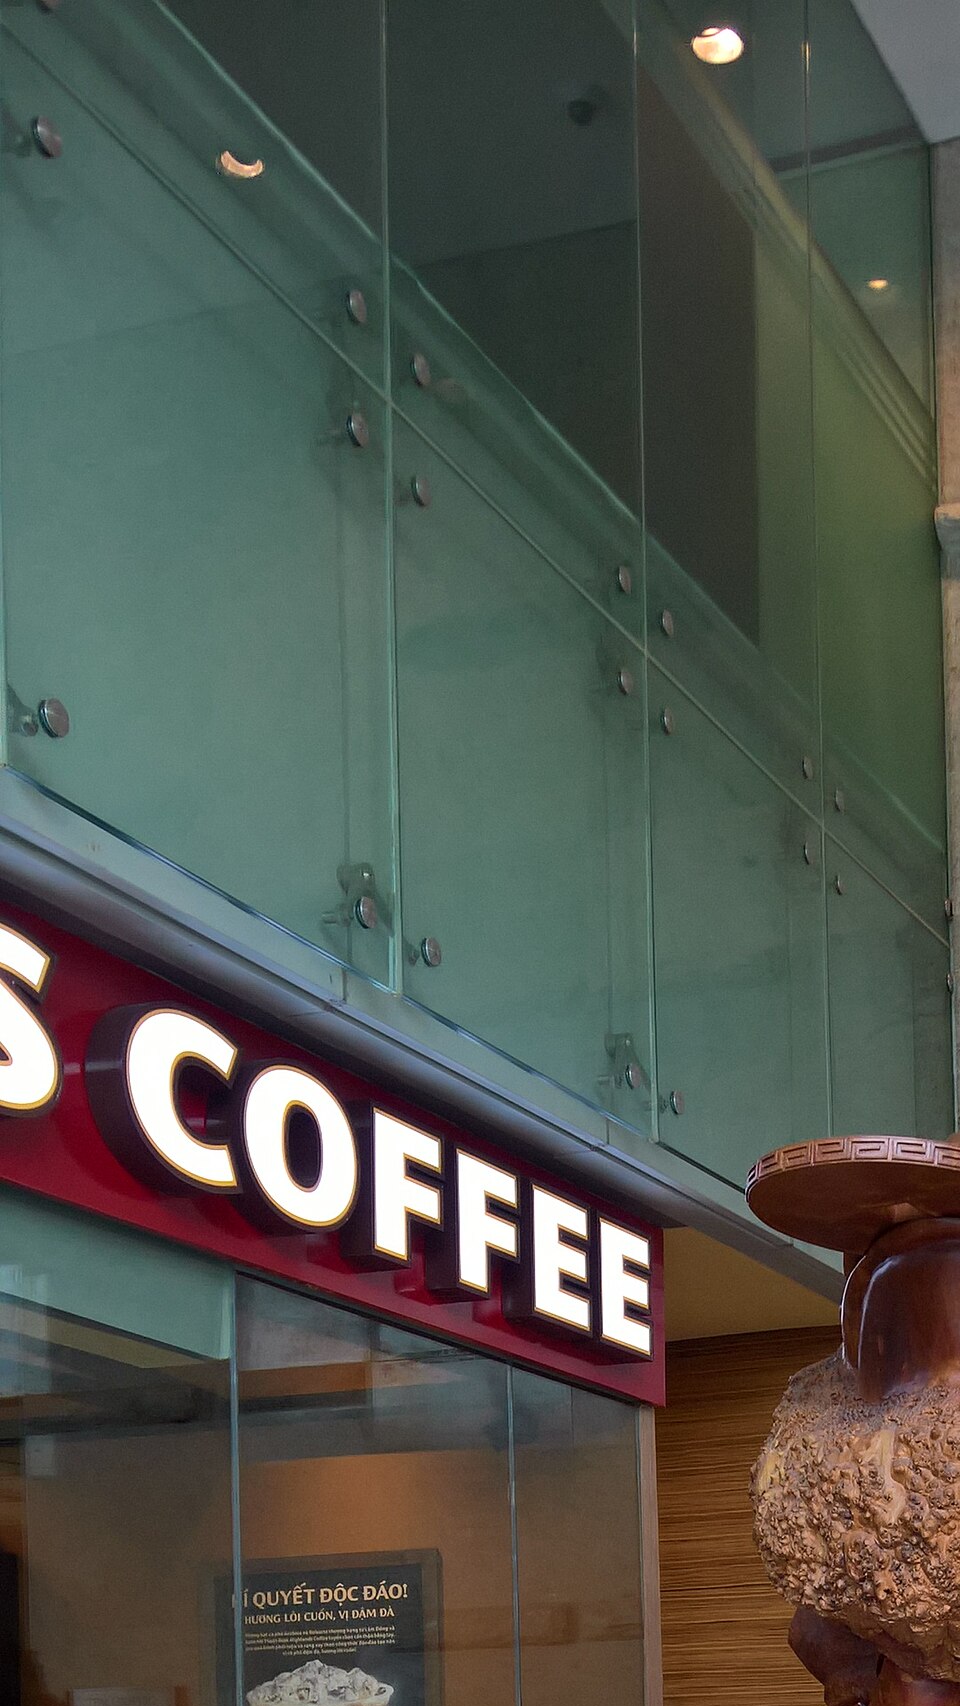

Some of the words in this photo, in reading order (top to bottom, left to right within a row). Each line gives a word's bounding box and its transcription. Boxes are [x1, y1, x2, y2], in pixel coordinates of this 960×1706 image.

[124, 1007, 653, 1357] COFFEE
[253, 1582, 315, 1609] QUYẾT
[320, 1582, 358, 1606] ĐỘC
[363, 1580, 408, 1600] ĐÁO!
[244, 1613, 281, 1625] HƯƠNG
[304, 1608, 336, 1622] CUỐN,
[352, 1606, 377, 1621] ĐẬM
[380, 1605, 395, 1618] ĐÀ
